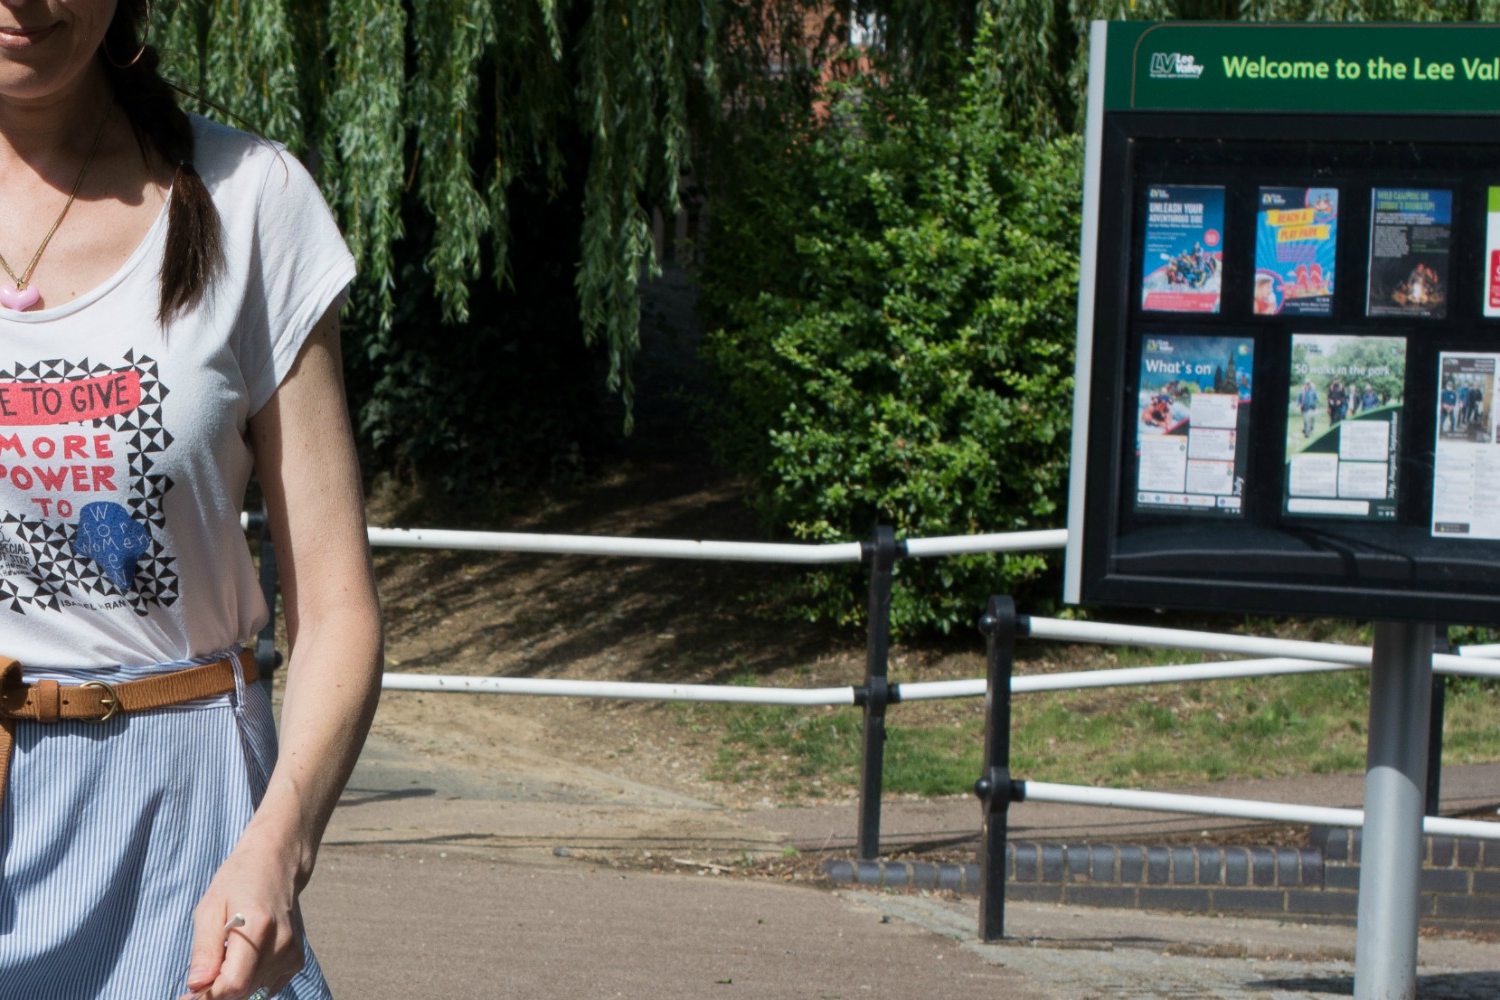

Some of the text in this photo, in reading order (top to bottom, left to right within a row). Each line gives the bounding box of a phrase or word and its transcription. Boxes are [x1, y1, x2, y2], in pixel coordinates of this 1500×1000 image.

[1176, 53, 1194, 64] Lee
[1175, 63, 1204, 76] Valley
[1222, 55, 1500, 81] Welcome to the Lee Val
[1149, 202, 1204, 215] UNLEASH YOUR
[1280, 227, 1317, 240] PLAY PARK
[1145, 359, 1212, 375] What's on
[1295, 363, 1390, 378] 50 walks in the park
[21, 387, 62, 416] TO
[70, 375, 130, 413] GIVE
[31, 497, 73, 518] TO
[9, 553, 32, 567] STAR
